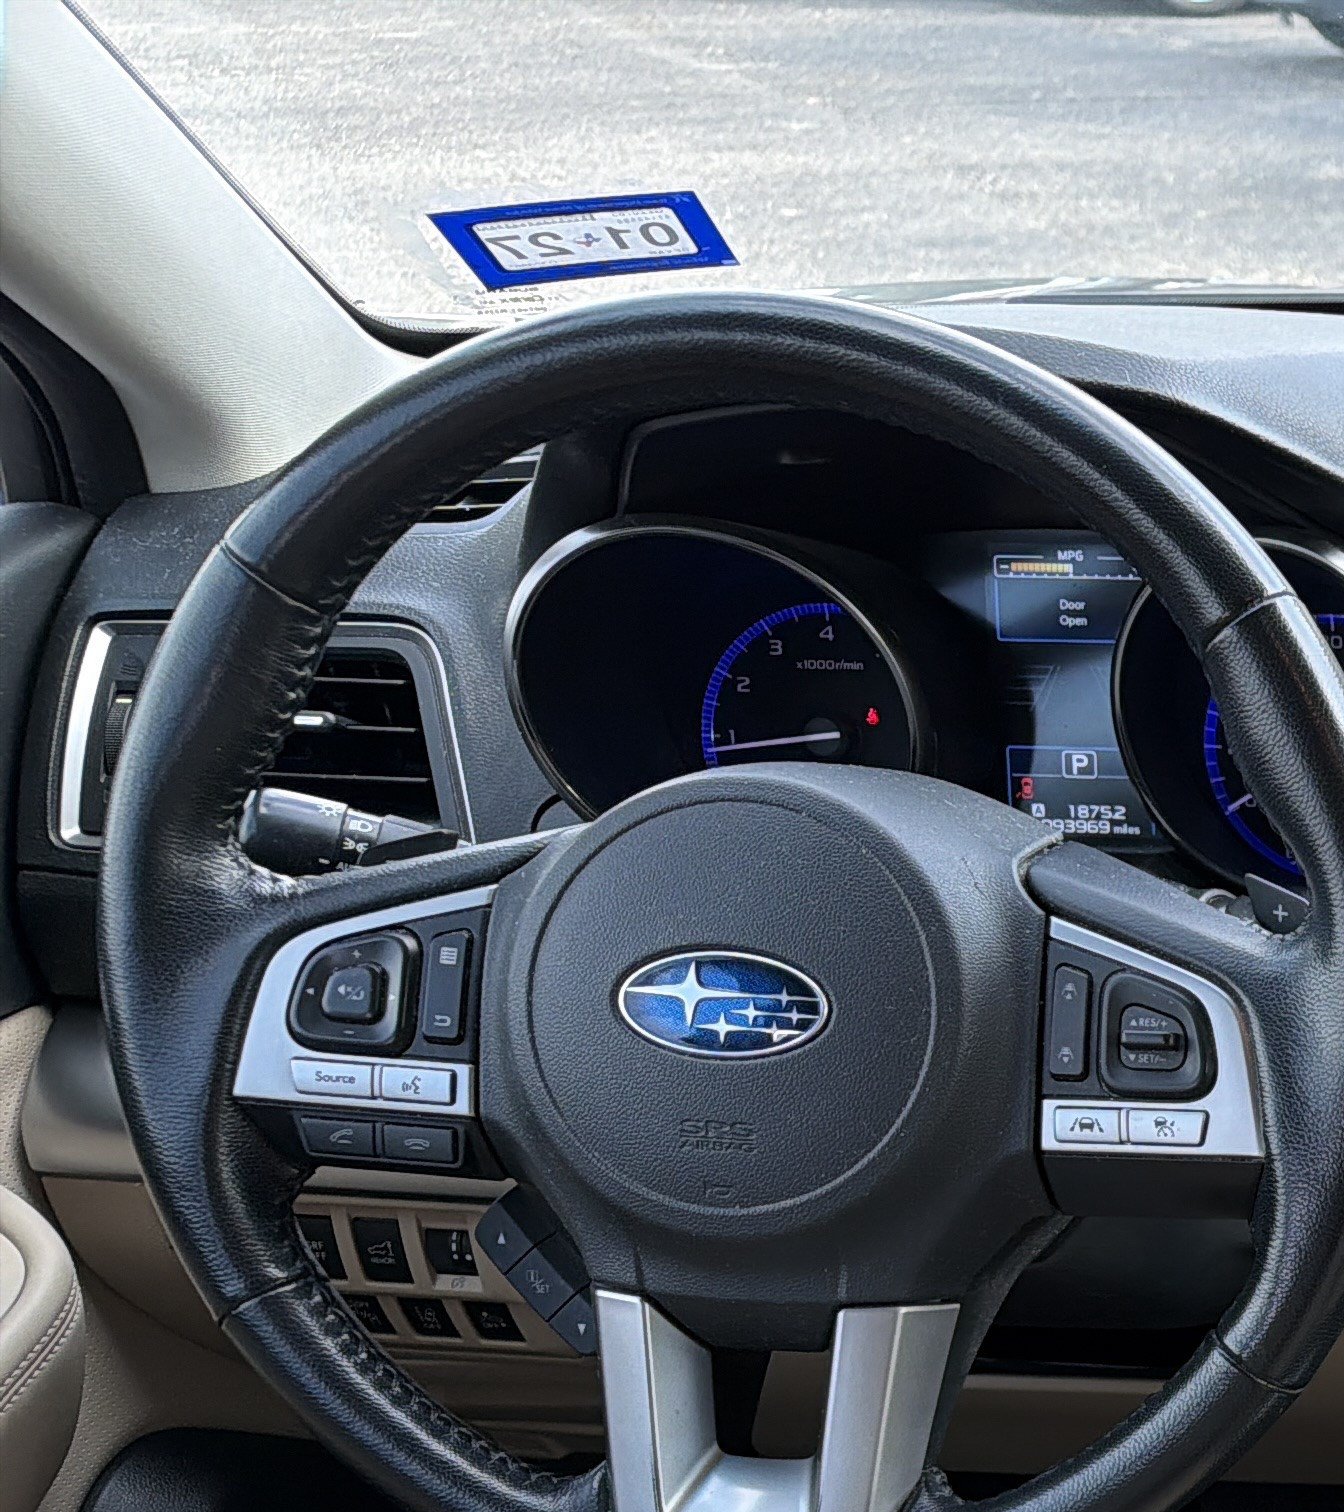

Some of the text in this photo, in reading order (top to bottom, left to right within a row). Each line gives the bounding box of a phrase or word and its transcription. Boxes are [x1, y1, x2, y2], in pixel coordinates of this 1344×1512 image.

[1057, 550, 1084, 561] MPG
[1059, 599, 1086, 610] Door
[1059, 616, 1088, 628] Open
[819, 625, 834, 641] 4
[769, 639, 783, 656] 3
[736, 676, 750, 693] 2
[728, 729, 735, 745] 1
[1071, 754, 1089, 775] P
[1113, 823, 1141, 835] miles
[314, 1070, 355, 1085] Source
